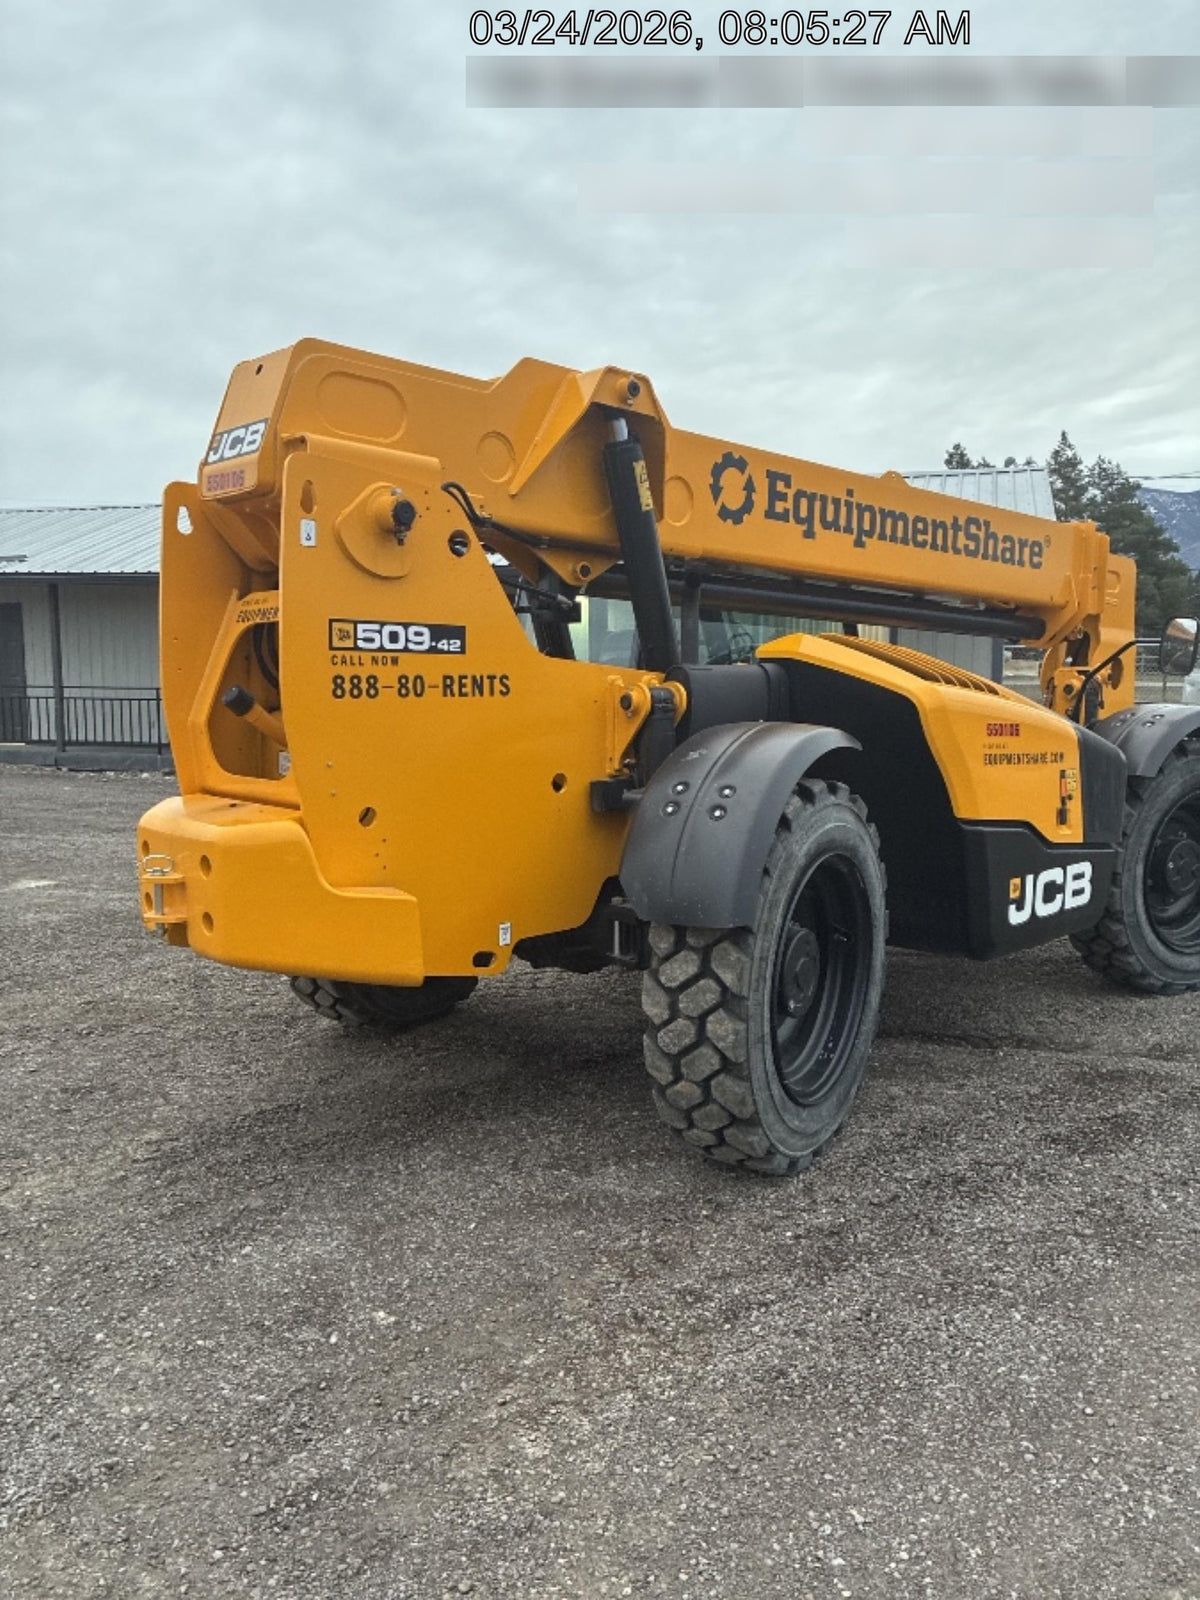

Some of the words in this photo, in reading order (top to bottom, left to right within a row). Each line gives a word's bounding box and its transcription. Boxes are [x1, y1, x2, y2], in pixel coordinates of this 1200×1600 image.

[207, 420, 267, 463] JCB
[764, 469, 1043, 570] EquipmentShare
[331, 654, 365, 667] CALL
[371, 655, 400, 667] NOW
[332, 674, 511, 699] 888-80-RENTS
[1008, 861, 1092, 926] JCB
